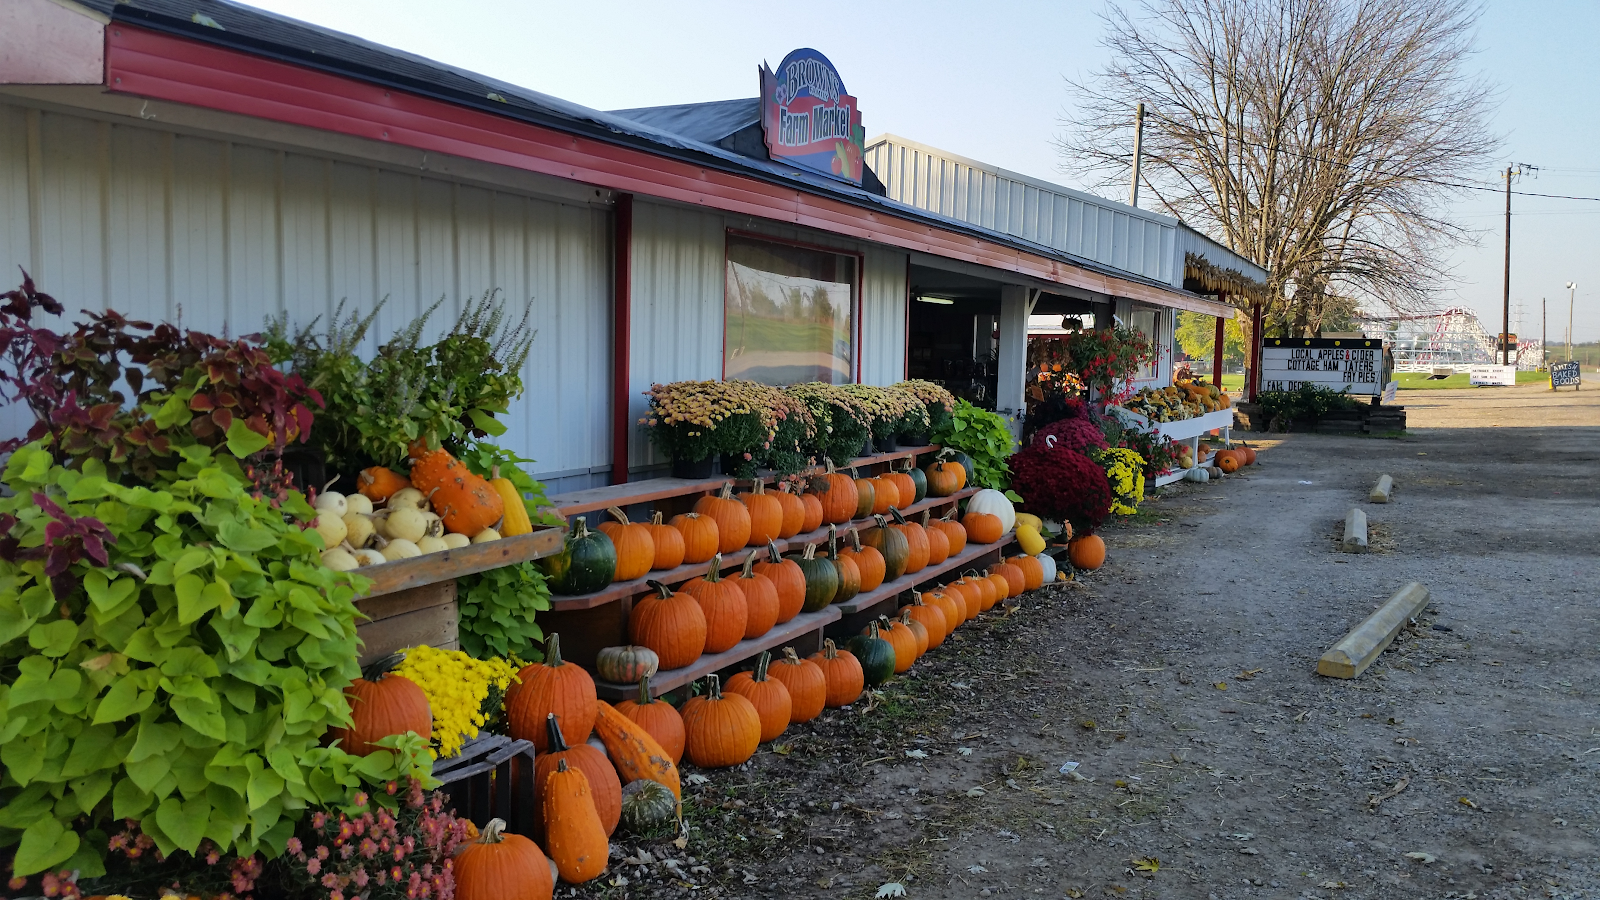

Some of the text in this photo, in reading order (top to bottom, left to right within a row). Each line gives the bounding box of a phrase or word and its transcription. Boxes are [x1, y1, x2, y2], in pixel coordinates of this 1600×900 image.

[779, 103, 850, 147] Farm Market
[1291, 349, 1374, 361] LOCAL APPLES & CIDER
[1287, 359, 1320, 370] COTTAGE
[1323, 360, 1339, 371] HAM
[1343, 371, 1376, 383] FRY PIES
[1552, 370, 1578, 379] BAKED
[1267, 381, 1284, 392] FALL
[1553, 377, 1580, 385] GOODS
